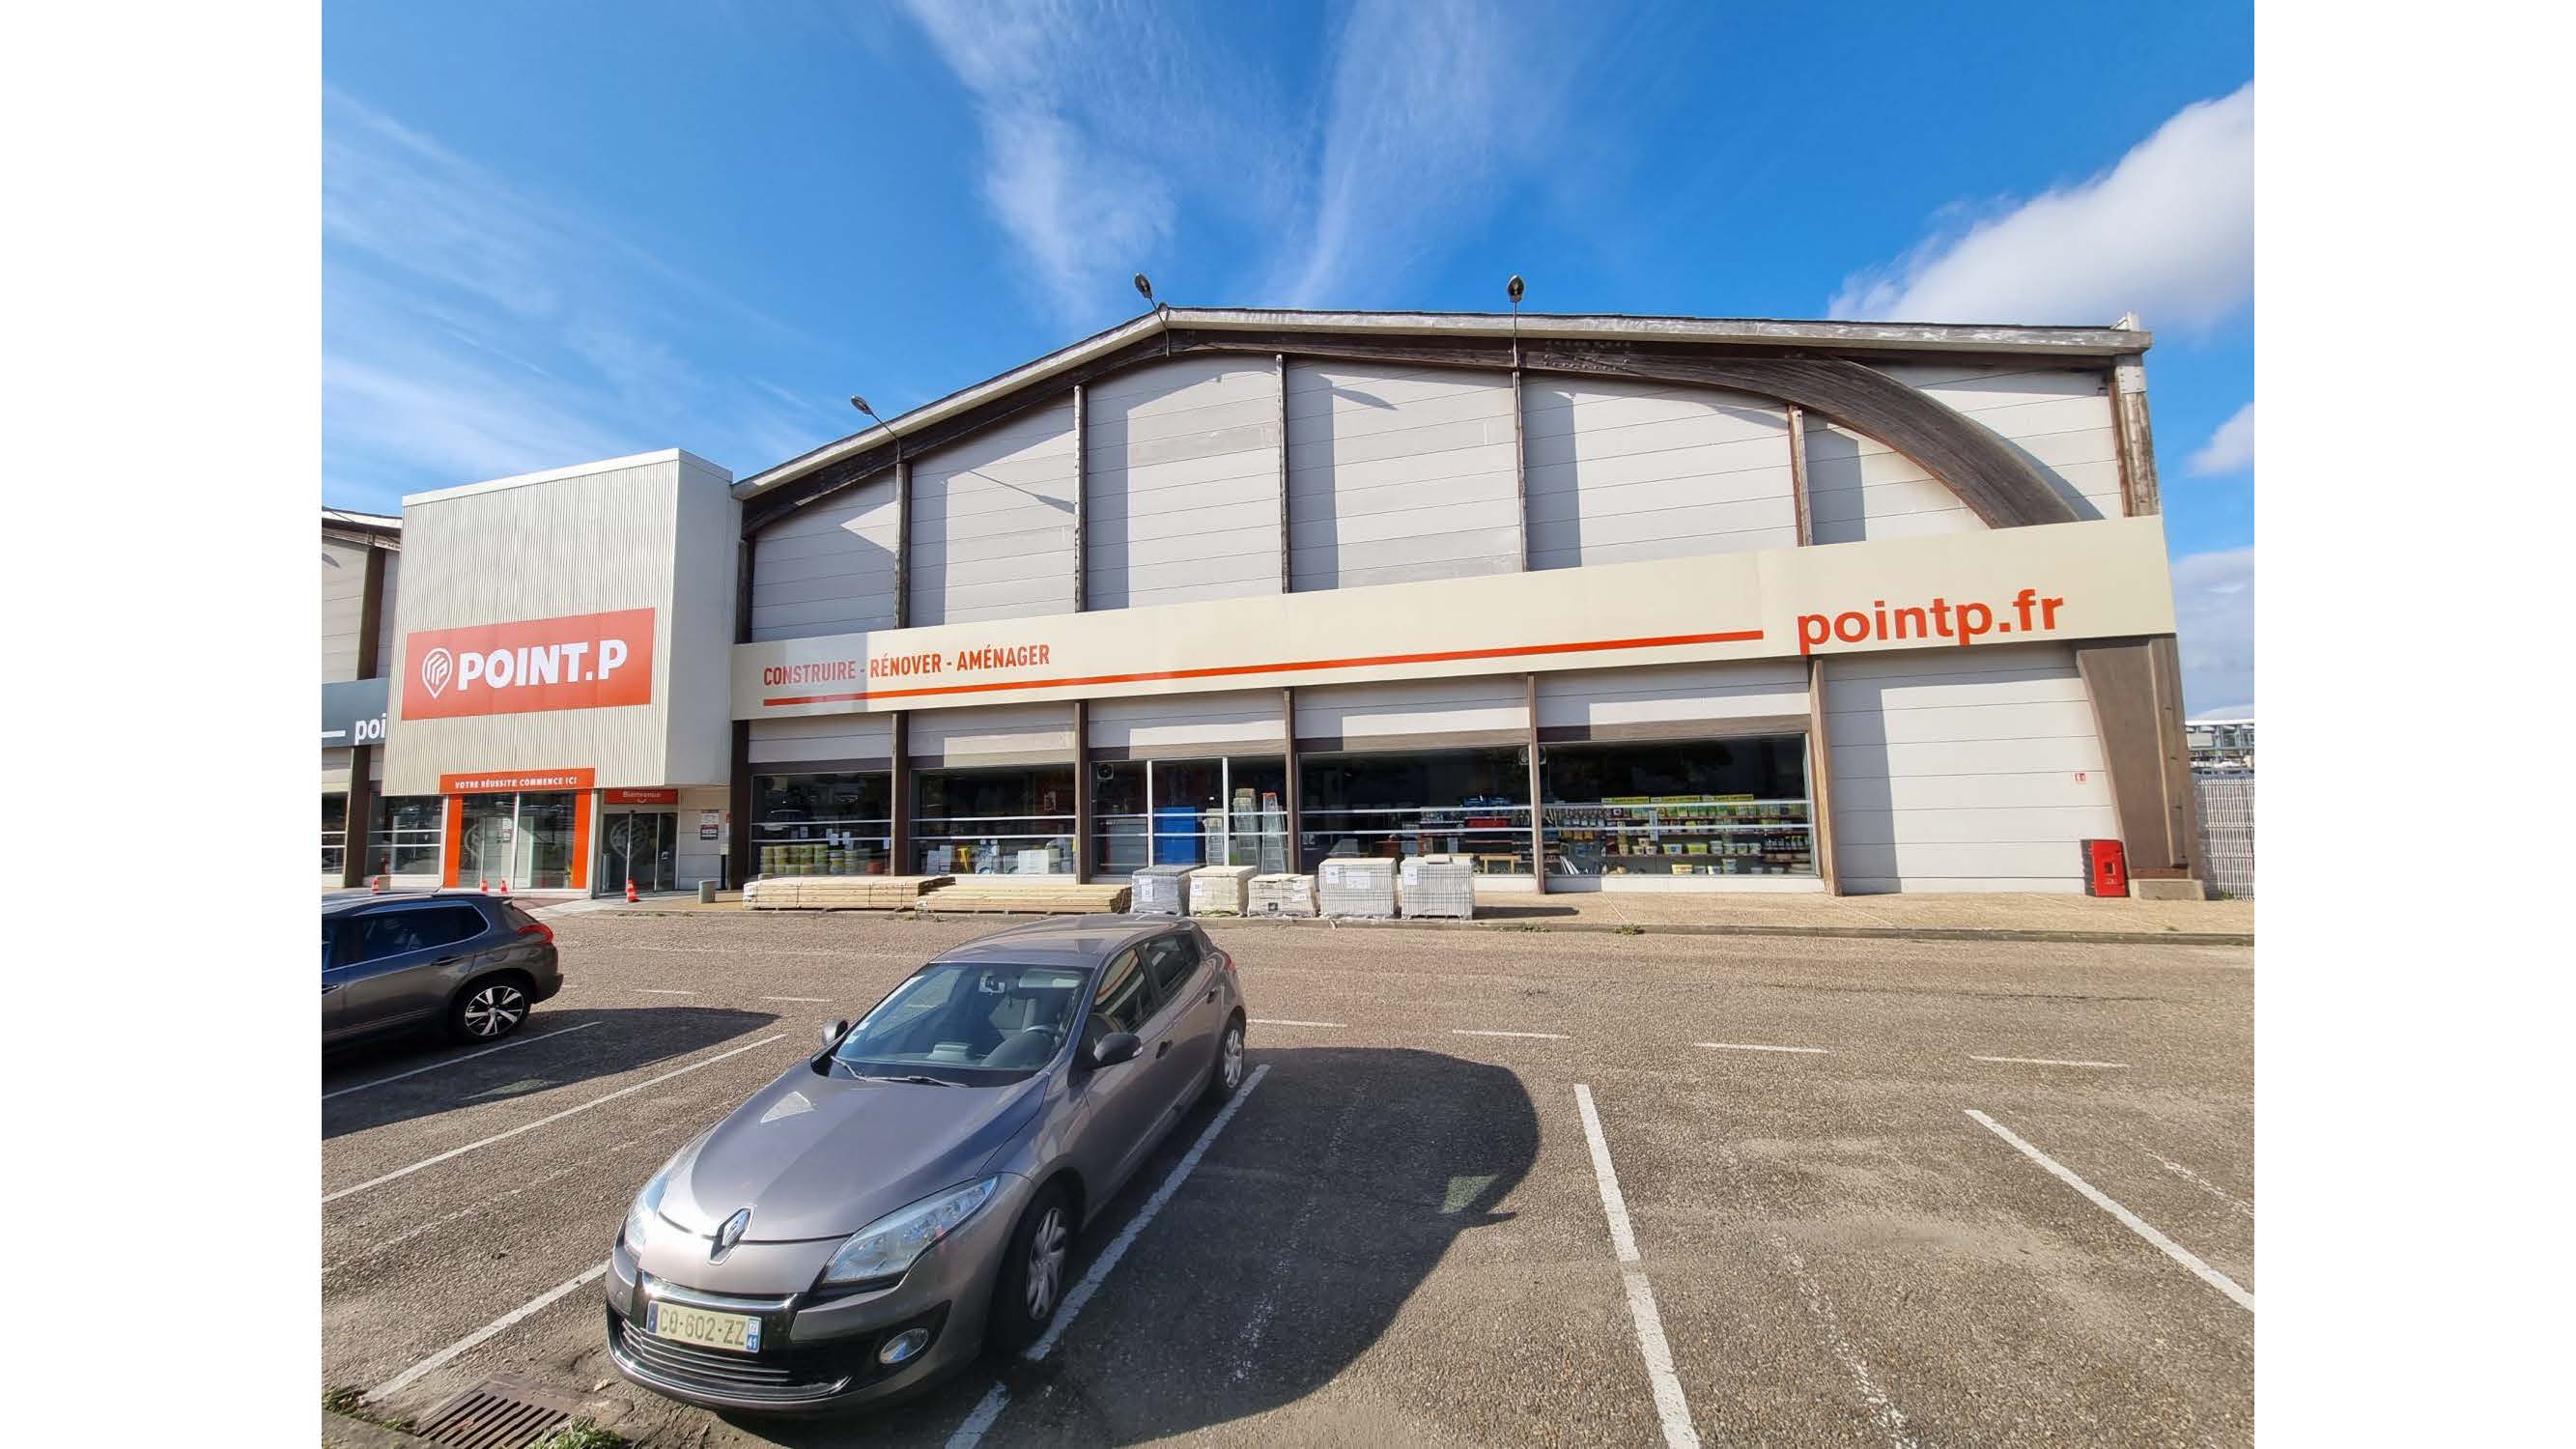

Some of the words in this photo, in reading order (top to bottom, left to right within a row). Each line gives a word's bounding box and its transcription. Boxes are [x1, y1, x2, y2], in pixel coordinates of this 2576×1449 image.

[1798, 589, 2064, 657] pointp.fr
[457, 639, 628, 691] POINT.P
[763, 661, 857, 686] CONSTRUIRE
[870, 653, 942, 678] RÉNOVER
[957, 644, 1050, 671] AMÉNAGER
[455, 780, 479, 789] VOTRE
[481, 778, 518, 788] RÉUSSITE
[519, 777, 563, 787] COMMENCE
[565, 776, 578, 784] ICI
